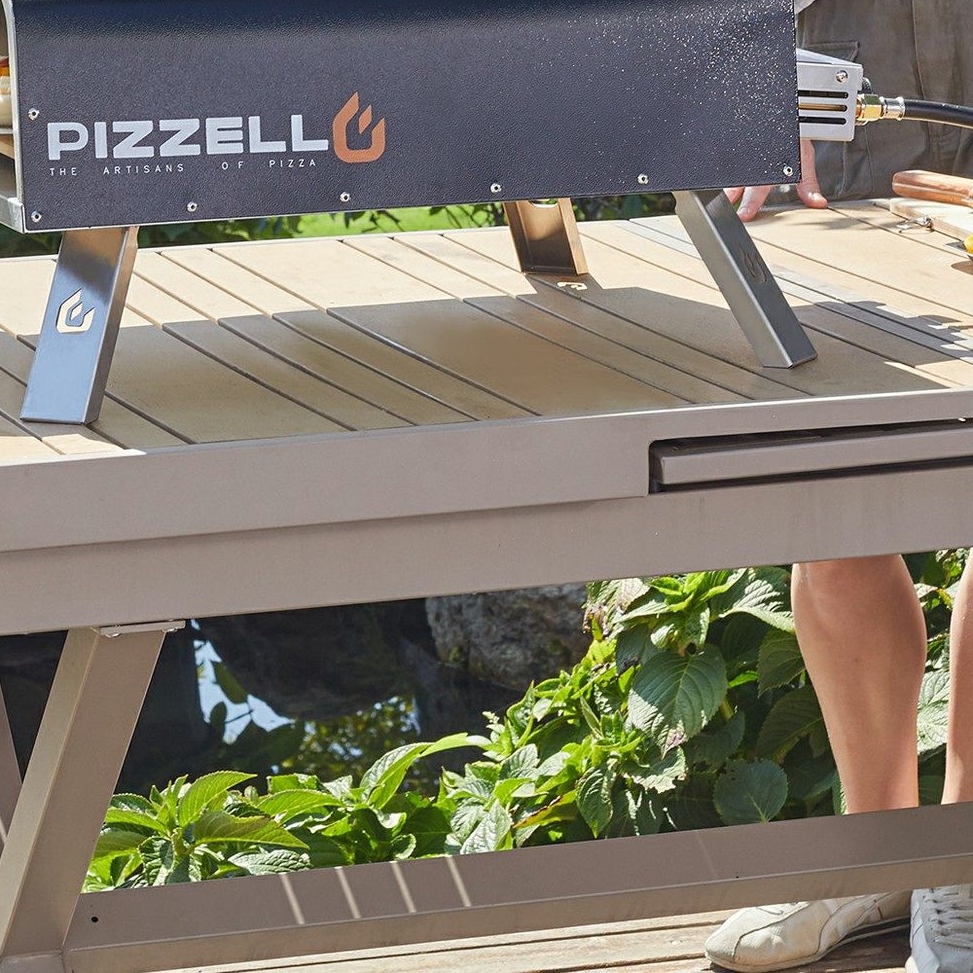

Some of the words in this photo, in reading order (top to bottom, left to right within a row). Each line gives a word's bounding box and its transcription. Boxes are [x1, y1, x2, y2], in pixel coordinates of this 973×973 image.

[49, 167, 77, 176] THE
[103, 163, 184, 175] ARTISANS
[221, 160, 244, 170] OF
[269, 159, 316, 168] PIZZA
